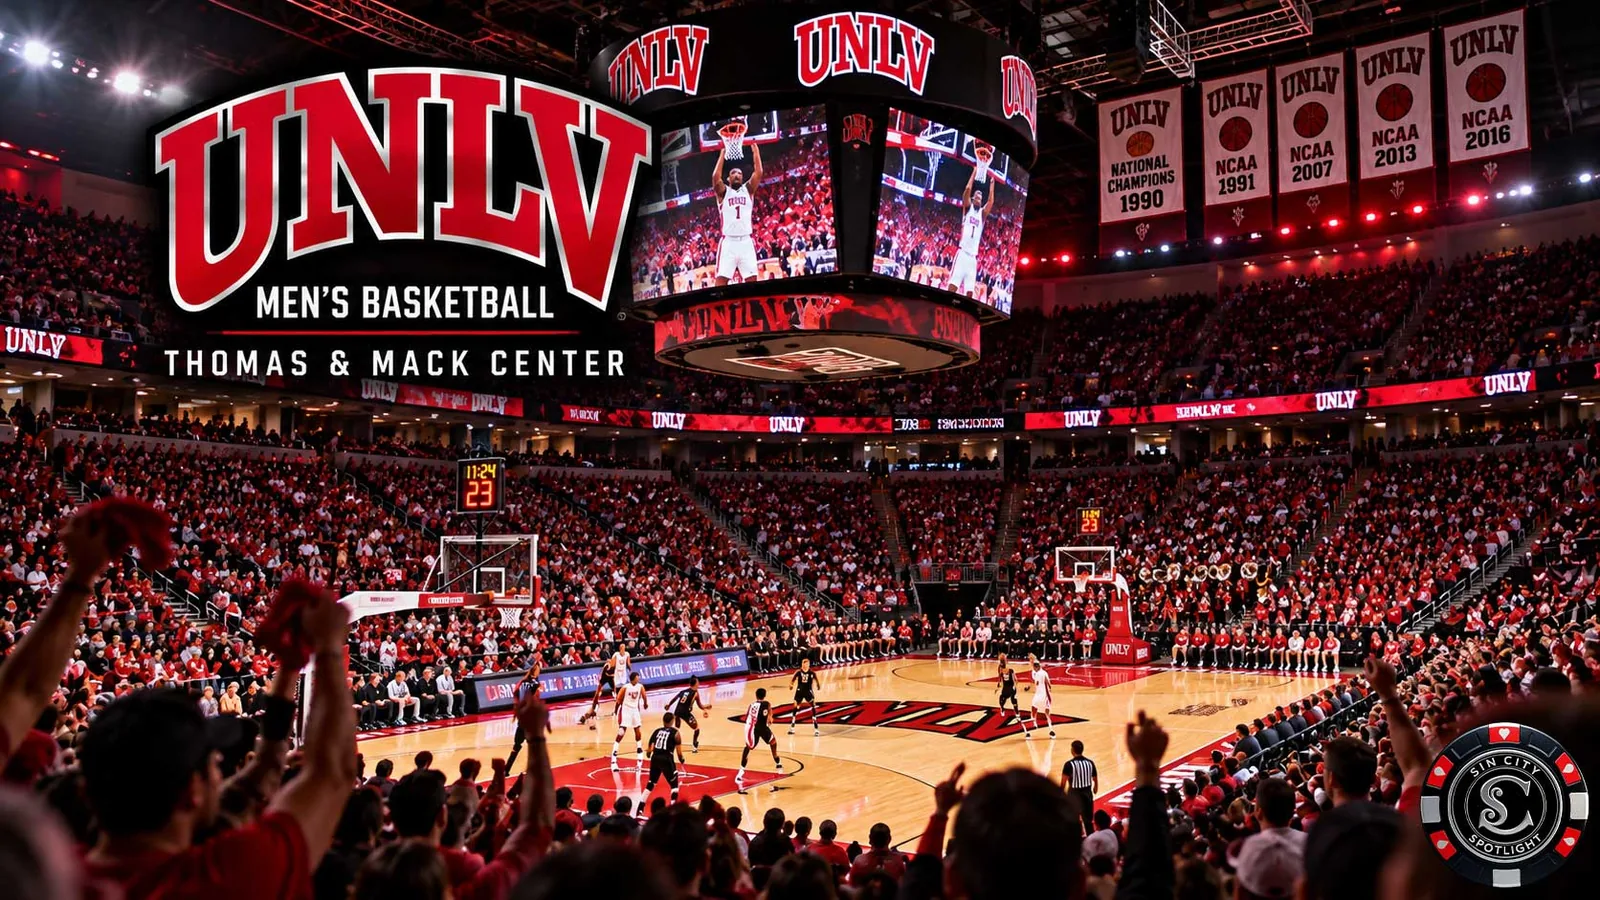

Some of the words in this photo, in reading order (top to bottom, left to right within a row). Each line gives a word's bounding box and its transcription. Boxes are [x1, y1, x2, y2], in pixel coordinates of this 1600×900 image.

[794, 11, 935, 96] UNLV
[1450, 24, 1519, 67] UNLV
[608, 24, 710, 105] UNLV
[1361, 46, 1426, 87] UNLV
[1281, 66, 1340, 104] UNLV
[1207, 83, 1263, 118] UNLV
[1111, 100, 1170, 136] UNLV
[1462, 104, 1513, 130] NCAA
[1372, 124, 1419, 147] NCAA
[1465, 124, 1511, 151] 2016
[1290, 140, 1335, 163] NCAA
[1374, 144, 1417, 168] 2013
[1111, 154, 1169, 178] NATIONAL
[1216, 155, 1258, 176] NCAA
[1292, 160, 1333, 183] 2007
[1107, 169, 1175, 194] CHAMPIONS
[1218, 173, 1256, 195] 1991
[1120, 189, 1164, 213] 1990
[5, 326, 66, 359] UNLV
[1484, 371, 1531, 396] UNLV
[1315, 390, 1358, 412] UNLV
[652, 411, 687, 430] UNLV
[769, 416, 804, 433] UNLV
[1064, 410, 1101, 428] UNLV
[466, 463, 497, 480] 11:24
[466, 480, 492, 507] 23
[1081, 519, 1098, 532] 23
